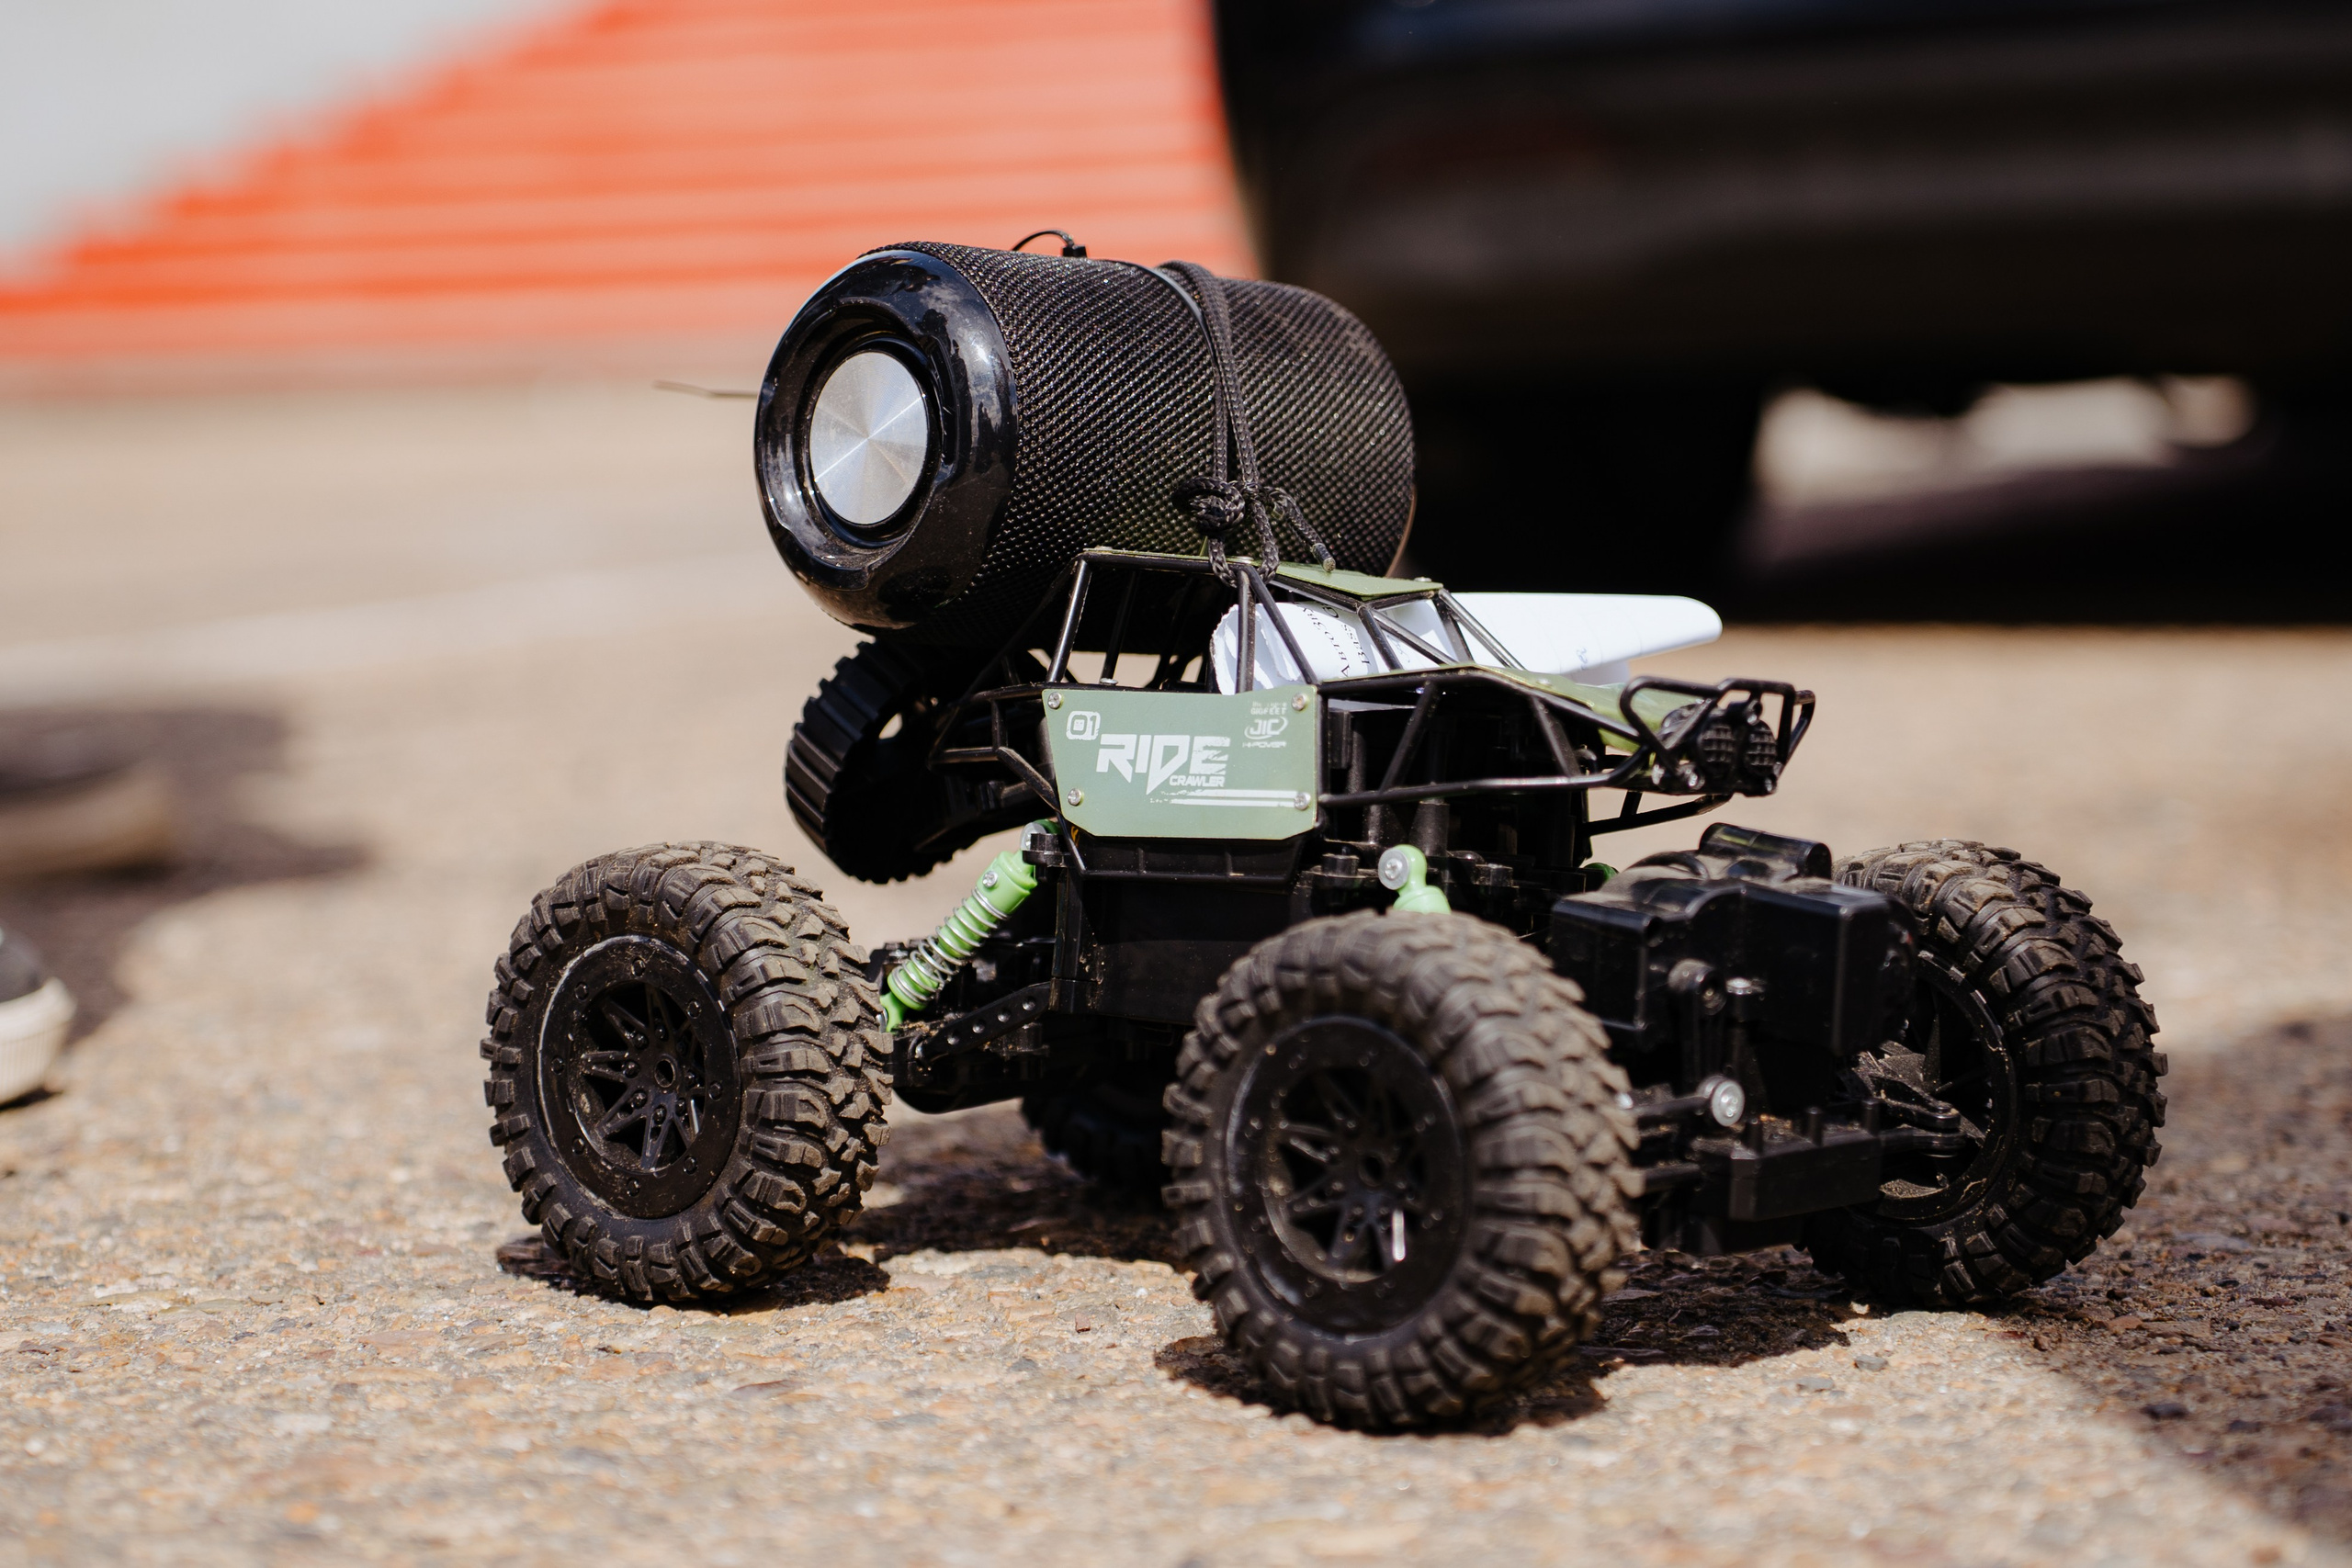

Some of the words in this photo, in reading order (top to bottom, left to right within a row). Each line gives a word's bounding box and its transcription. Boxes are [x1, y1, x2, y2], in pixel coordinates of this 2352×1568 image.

[1069, 713, 1099, 739] 01
[1096, 734, 1230, 795] RIDE
[1170, 775, 1226, 788] CRAWLER
